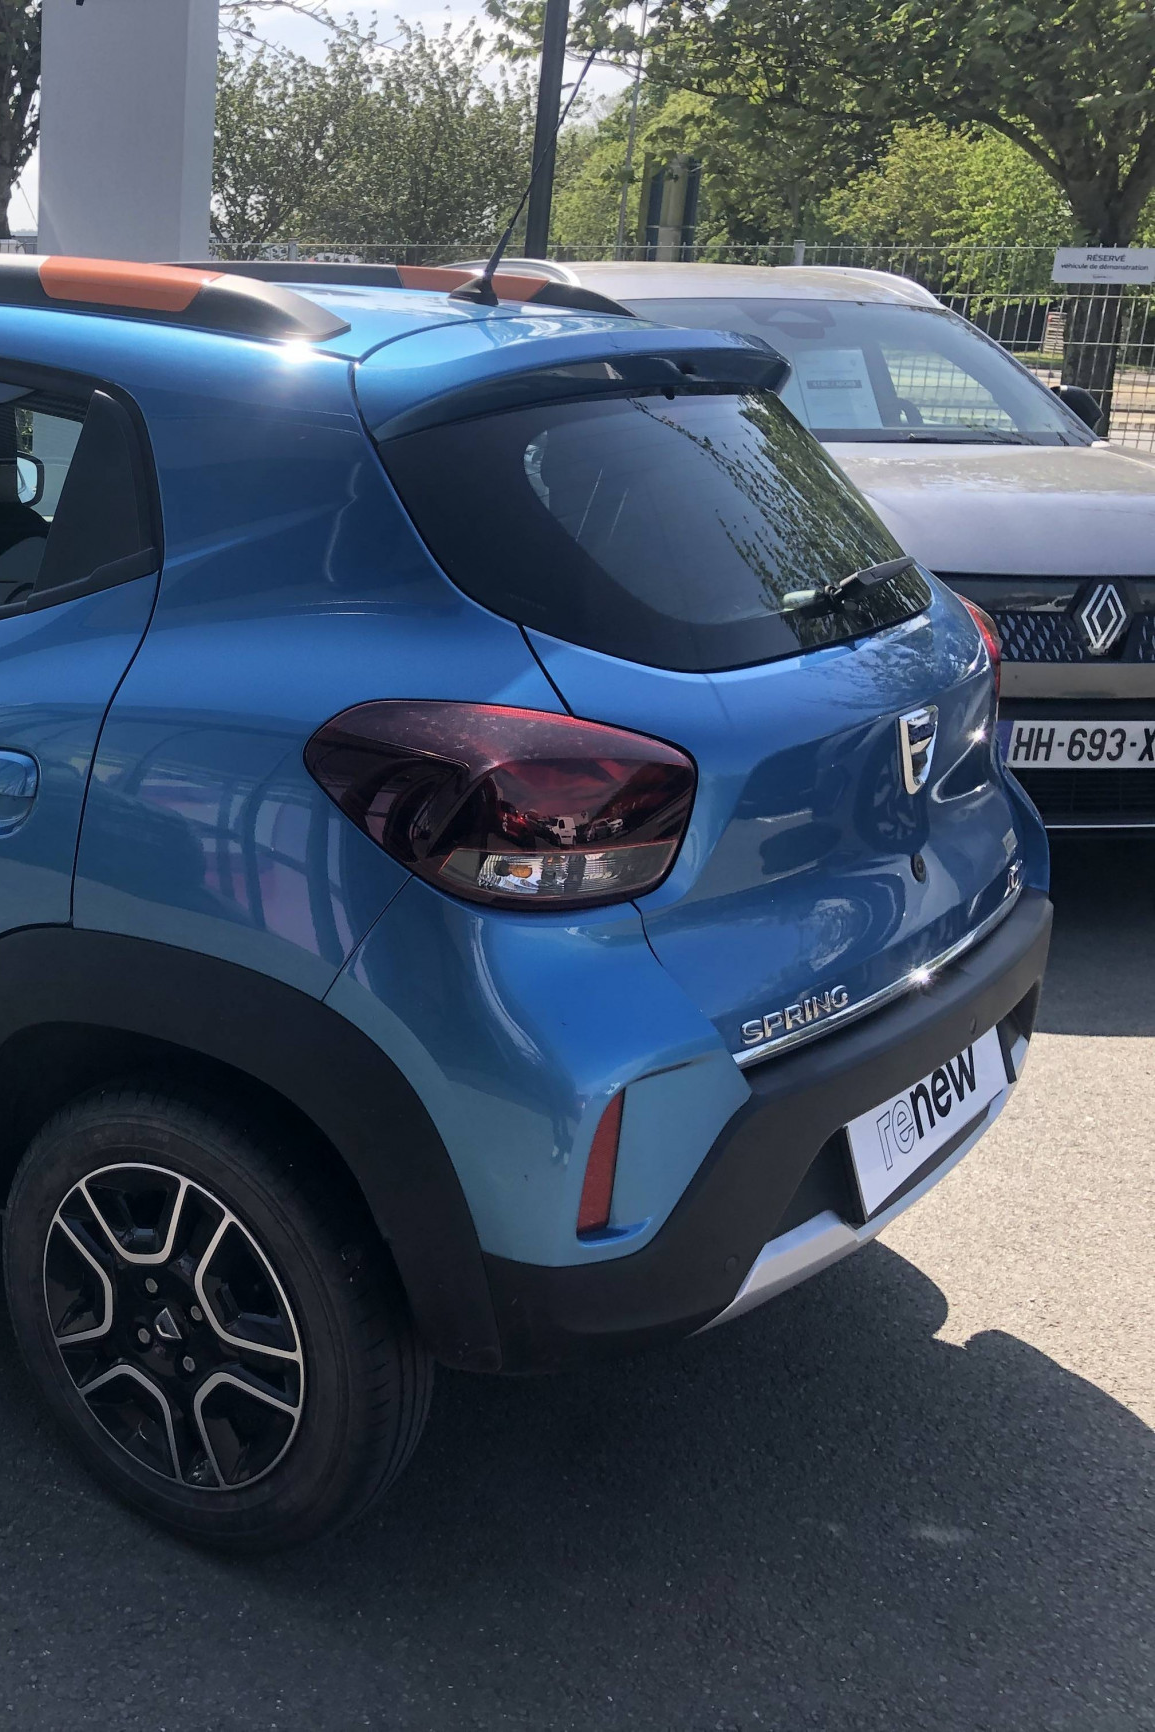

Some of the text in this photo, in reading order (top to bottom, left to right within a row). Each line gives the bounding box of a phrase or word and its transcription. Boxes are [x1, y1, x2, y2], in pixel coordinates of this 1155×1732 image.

[1086, 254, 1126, 262] RÉSERVÉ
[741, 984, 849, 1045] SPRING
[876, 1044, 976, 1171] renew
